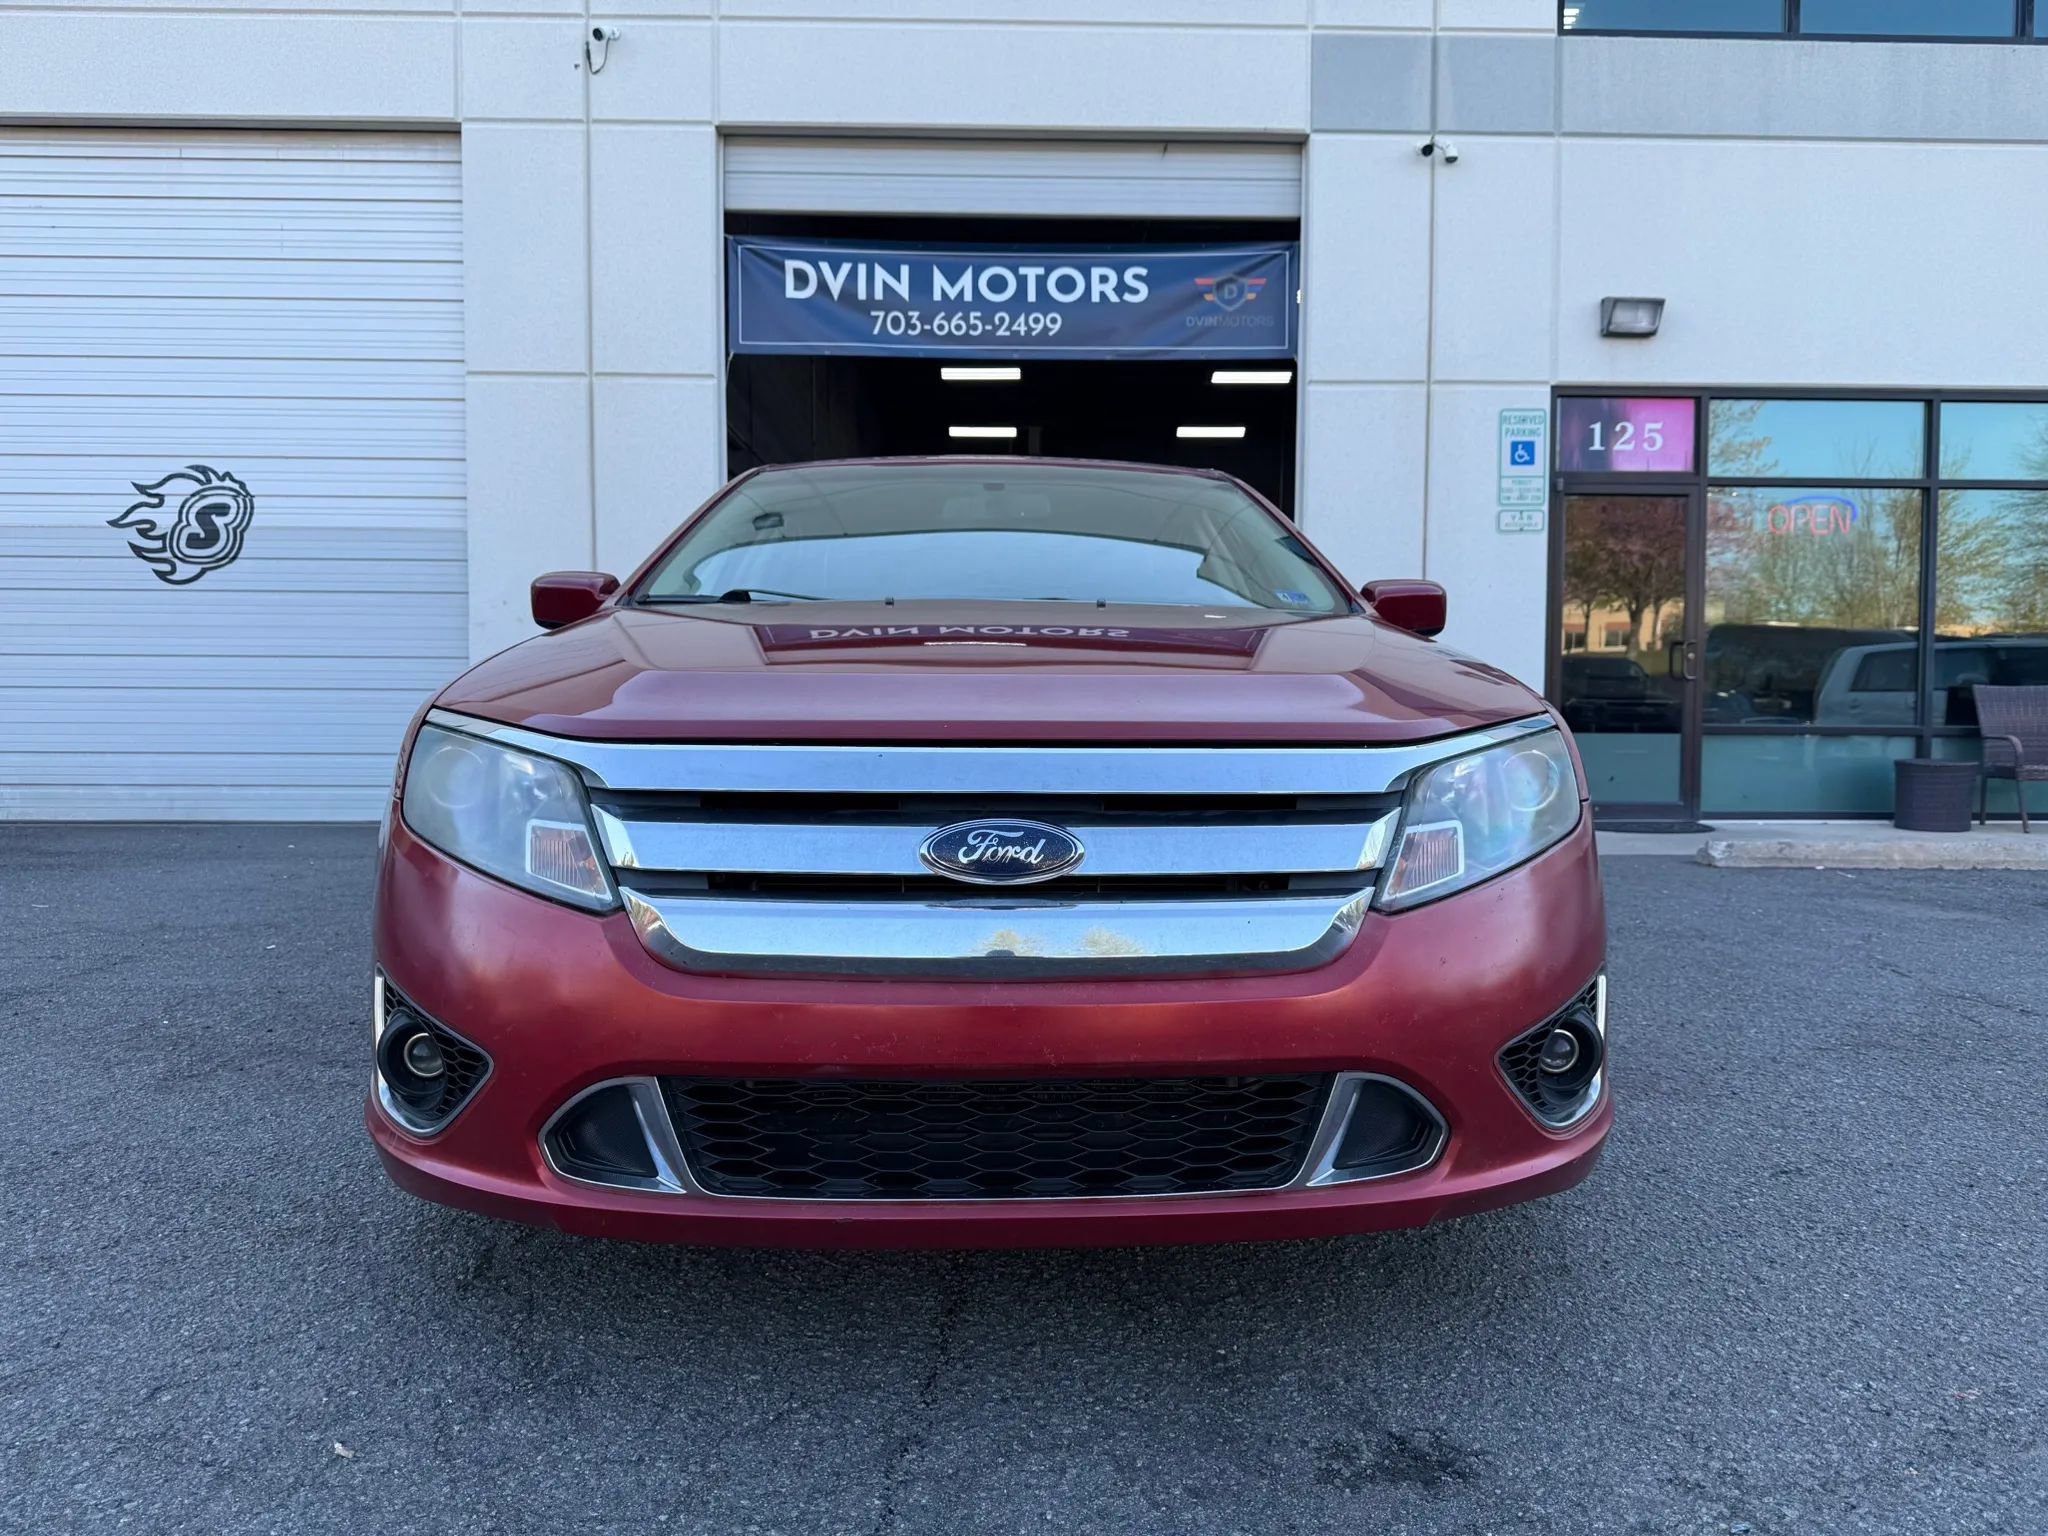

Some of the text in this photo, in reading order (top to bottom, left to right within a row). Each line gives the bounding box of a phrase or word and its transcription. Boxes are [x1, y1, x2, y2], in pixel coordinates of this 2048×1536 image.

[784, 259, 1149, 304] DVIN MOTORS
[870, 310, 1063, 337] 703-665-2499
[1504, 427, 1542, 438] PARKING
[1588, 420, 1664, 452] 125
[1767, 504, 1851, 535] OPEN
[957, 829, 1045, 864] Ford
